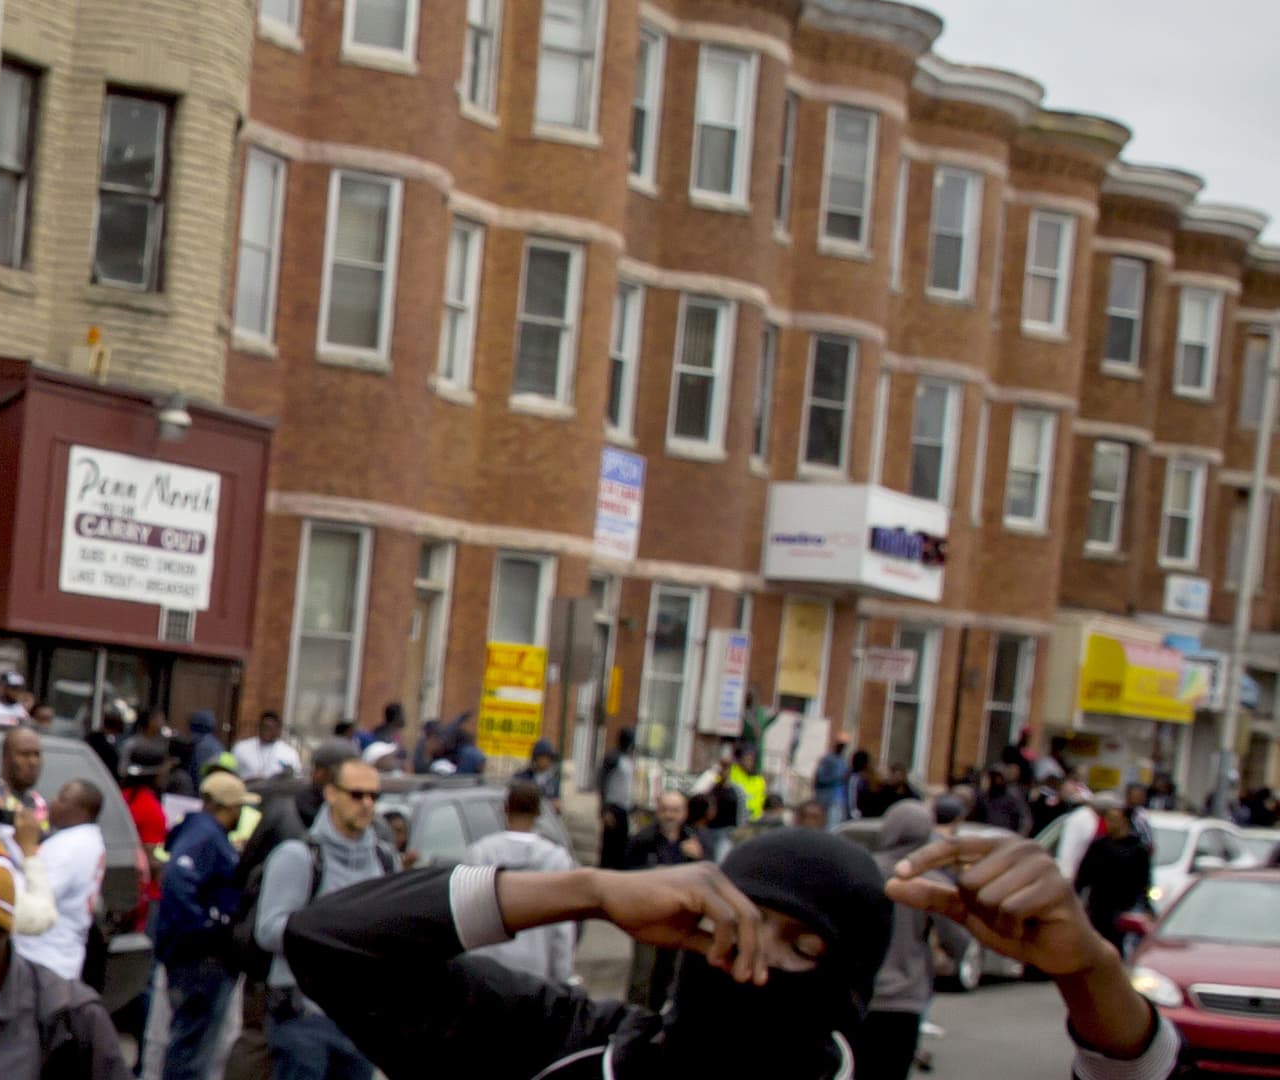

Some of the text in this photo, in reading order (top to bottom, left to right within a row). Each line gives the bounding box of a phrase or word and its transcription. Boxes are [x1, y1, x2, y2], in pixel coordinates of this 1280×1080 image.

[76, 457, 214, 514] Penn North
[79, 512, 203, 554] CARRY OUT
